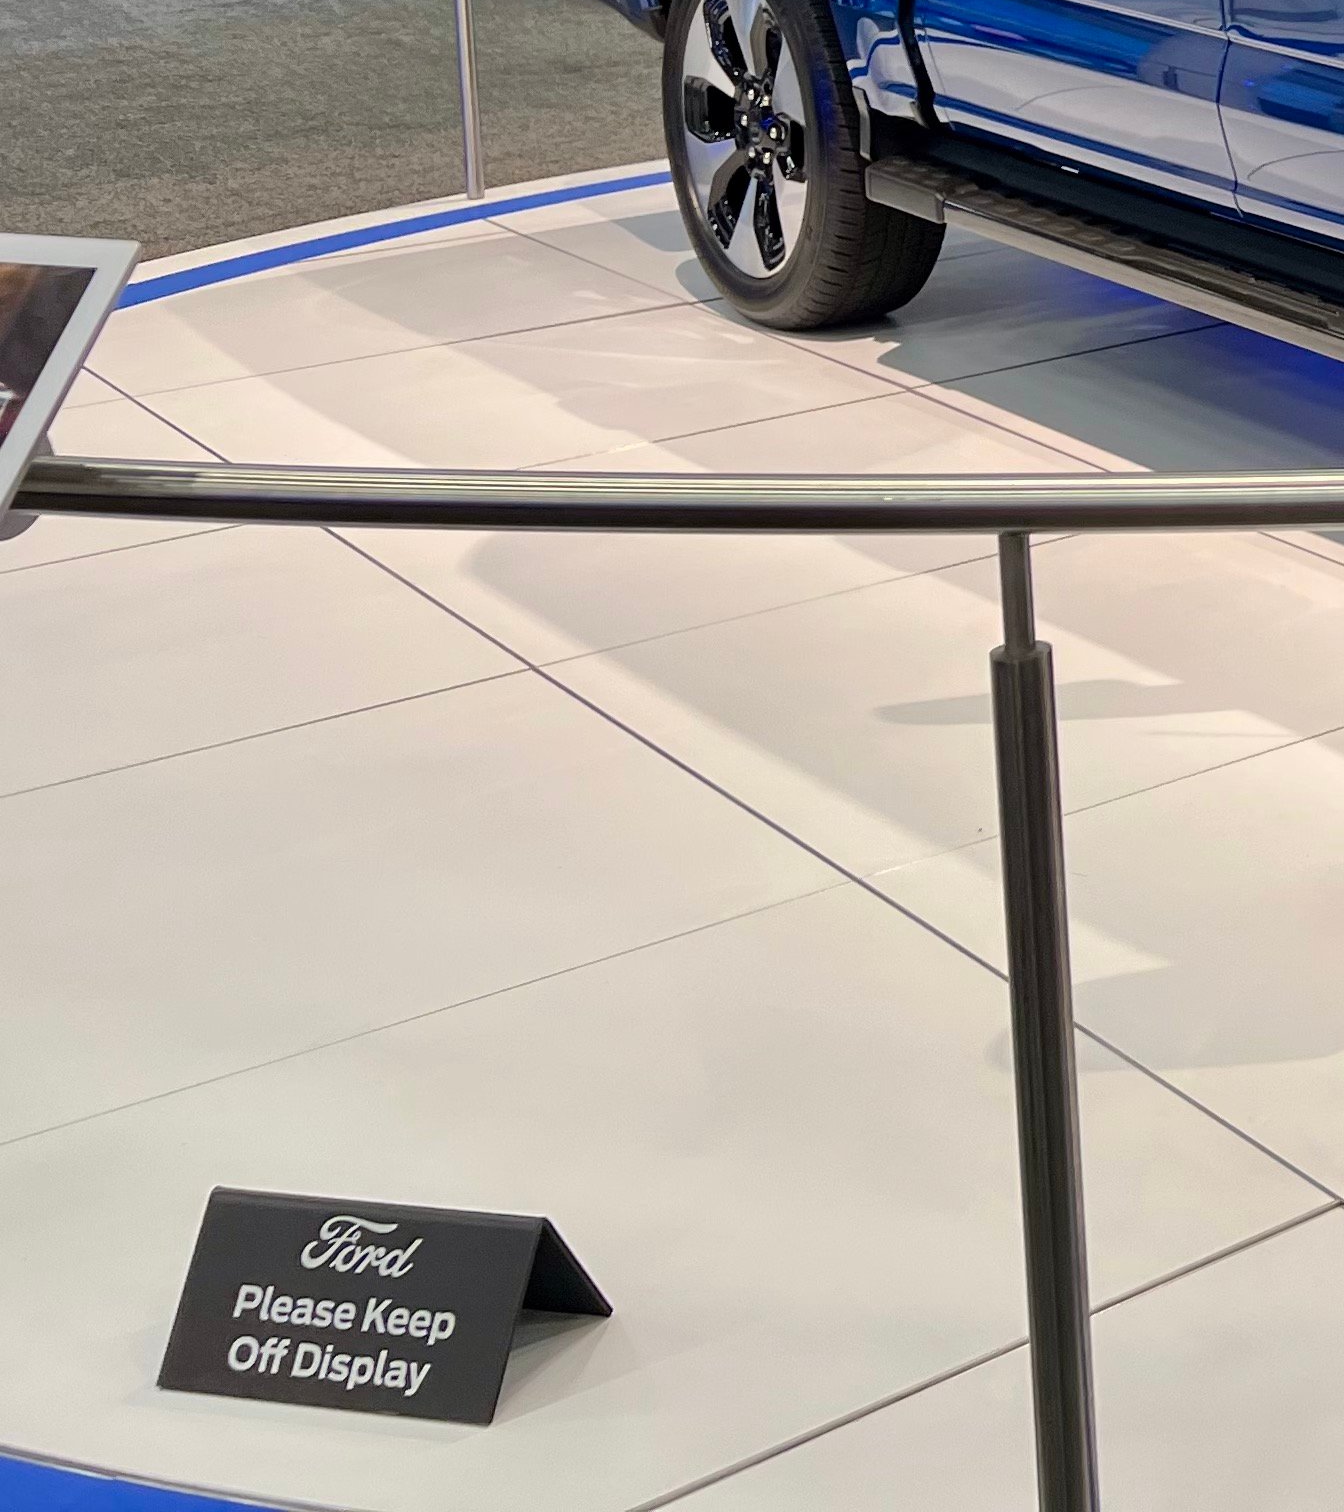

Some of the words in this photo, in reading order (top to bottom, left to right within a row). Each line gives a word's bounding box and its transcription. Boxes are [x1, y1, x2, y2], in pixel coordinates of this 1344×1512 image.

[301, 1214, 424, 1279] Ford
[232, 1284, 357, 1331] Please
[360, 1297, 457, 1346] Keep
[227, 1335, 292, 1375] Off
[290, 1341, 432, 1397] Display
